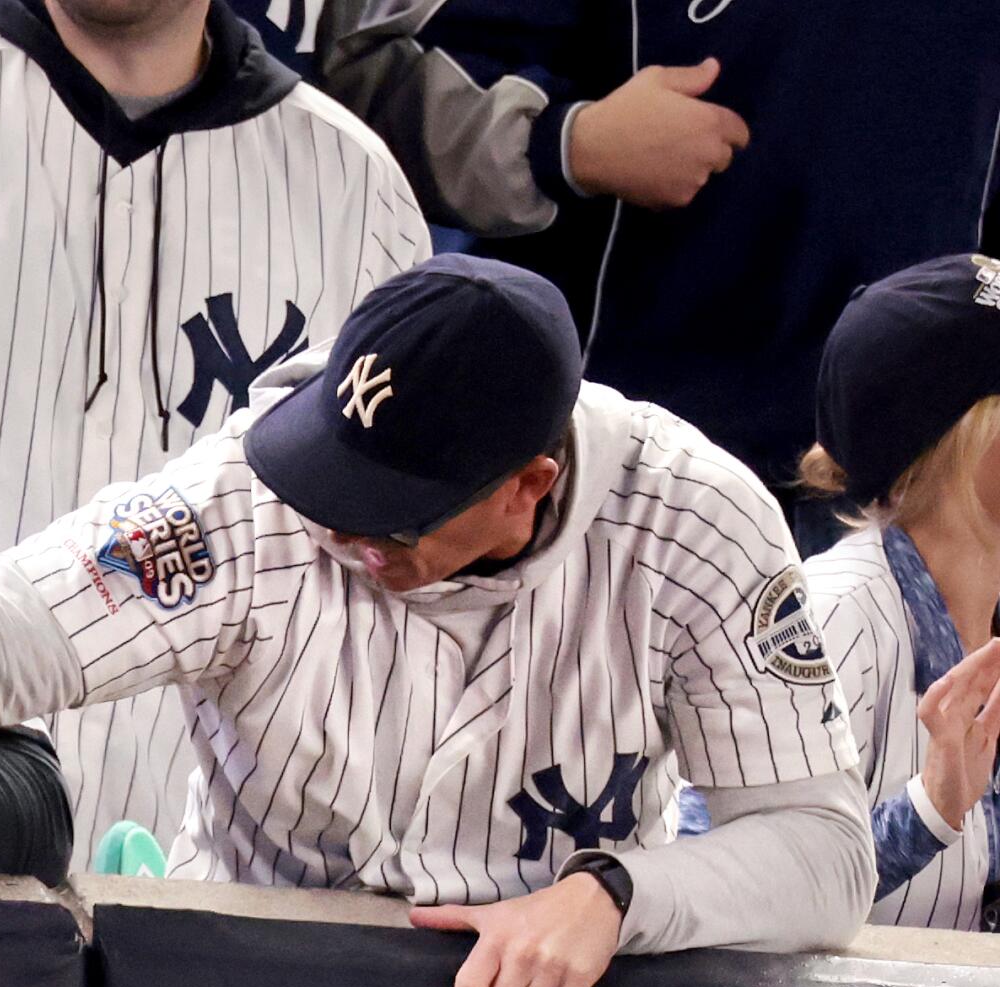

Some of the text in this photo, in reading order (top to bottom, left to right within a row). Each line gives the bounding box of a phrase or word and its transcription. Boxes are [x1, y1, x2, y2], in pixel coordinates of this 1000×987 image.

[336, 353, 394, 429] NY
[63, 538, 119, 615] CHAMPIONS
[114, 494, 196, 609] SERIES
[154, 487, 214, 585] WORLD
[506, 752, 650, 861] NY
